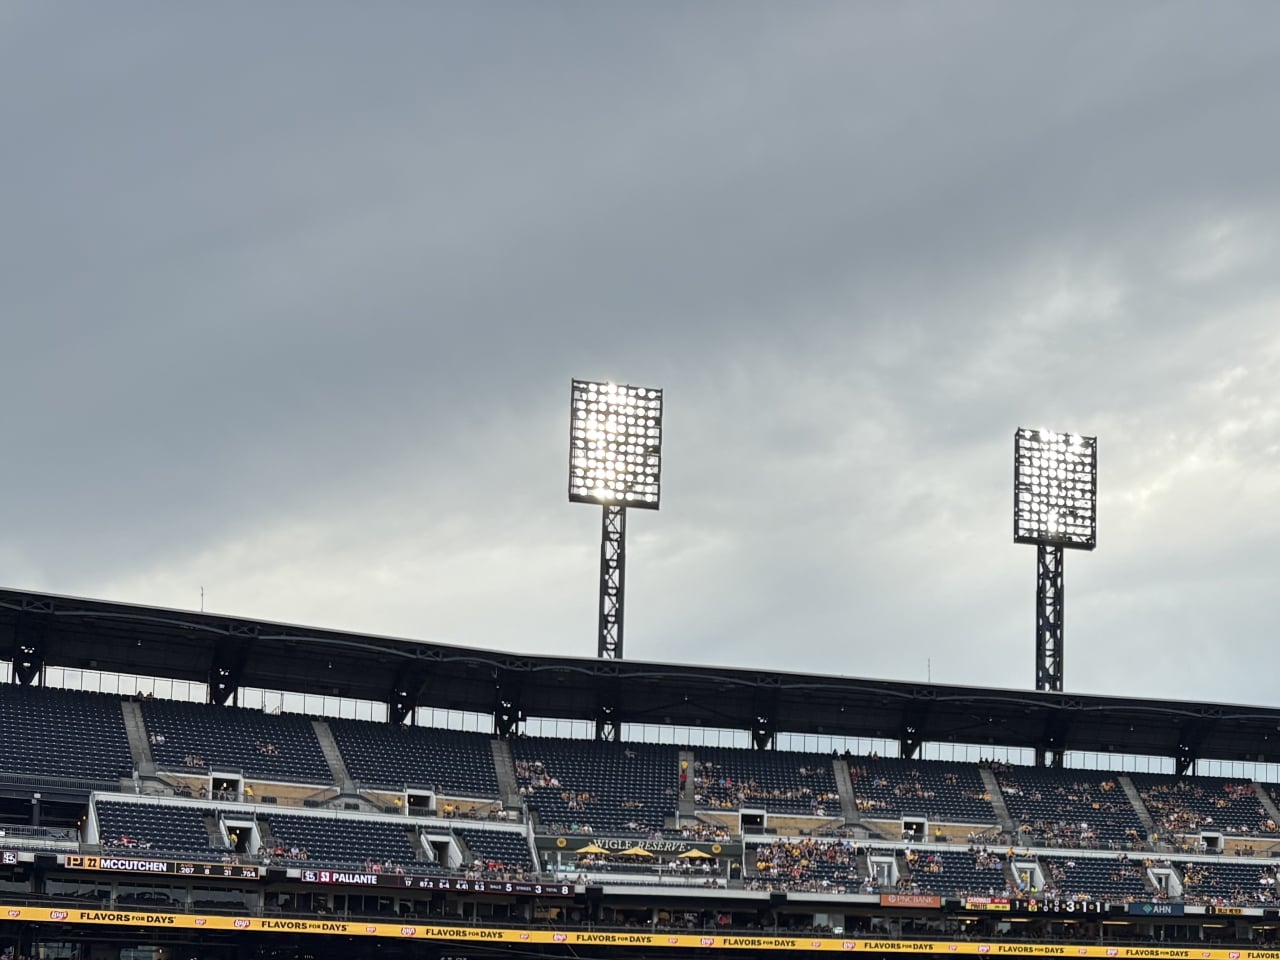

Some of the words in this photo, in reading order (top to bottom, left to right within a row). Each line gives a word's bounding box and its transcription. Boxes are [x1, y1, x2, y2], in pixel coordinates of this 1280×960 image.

[593, 839, 632, 851] WIGLE
[638, 841, 686, 852] RESERVE
[100, 859, 167, 872] MCCUTCHEN
[332, 872, 377, 885] PALLANTE
[505, 884, 512, 892] 5
[535, 885, 542, 894] 3
[561, 886, 569, 895] 8
[1066, 901, 1075, 912] 3
[1081, 901, 1086, 913] 1
[1095, 901, 1101, 913] 1
[1153, 905, 1172, 914] AHN
[80, 912, 130, 922] FLAVORS
[147, 914, 175, 924] DAYS
[261, 920, 307, 929] FLAVORS
[322, 923, 347, 931] DAYS
[426, 928, 467, 937] FLAVORS
[480, 931, 503, 939] DAYS
[576, 934, 617, 942] FLAVORS
[629, 935, 652, 943] DAYS
[723, 938, 762, 946] FLAVORS
[864, 942, 901, 950] FLAVORS
[998, 945, 1034, 953] FLAVORS
[1044, 946, 1065, 954] DAYS
[1126, 949, 1160, 957] FLAVORS
[1247, 952, 1280, 960] FLAVORS
